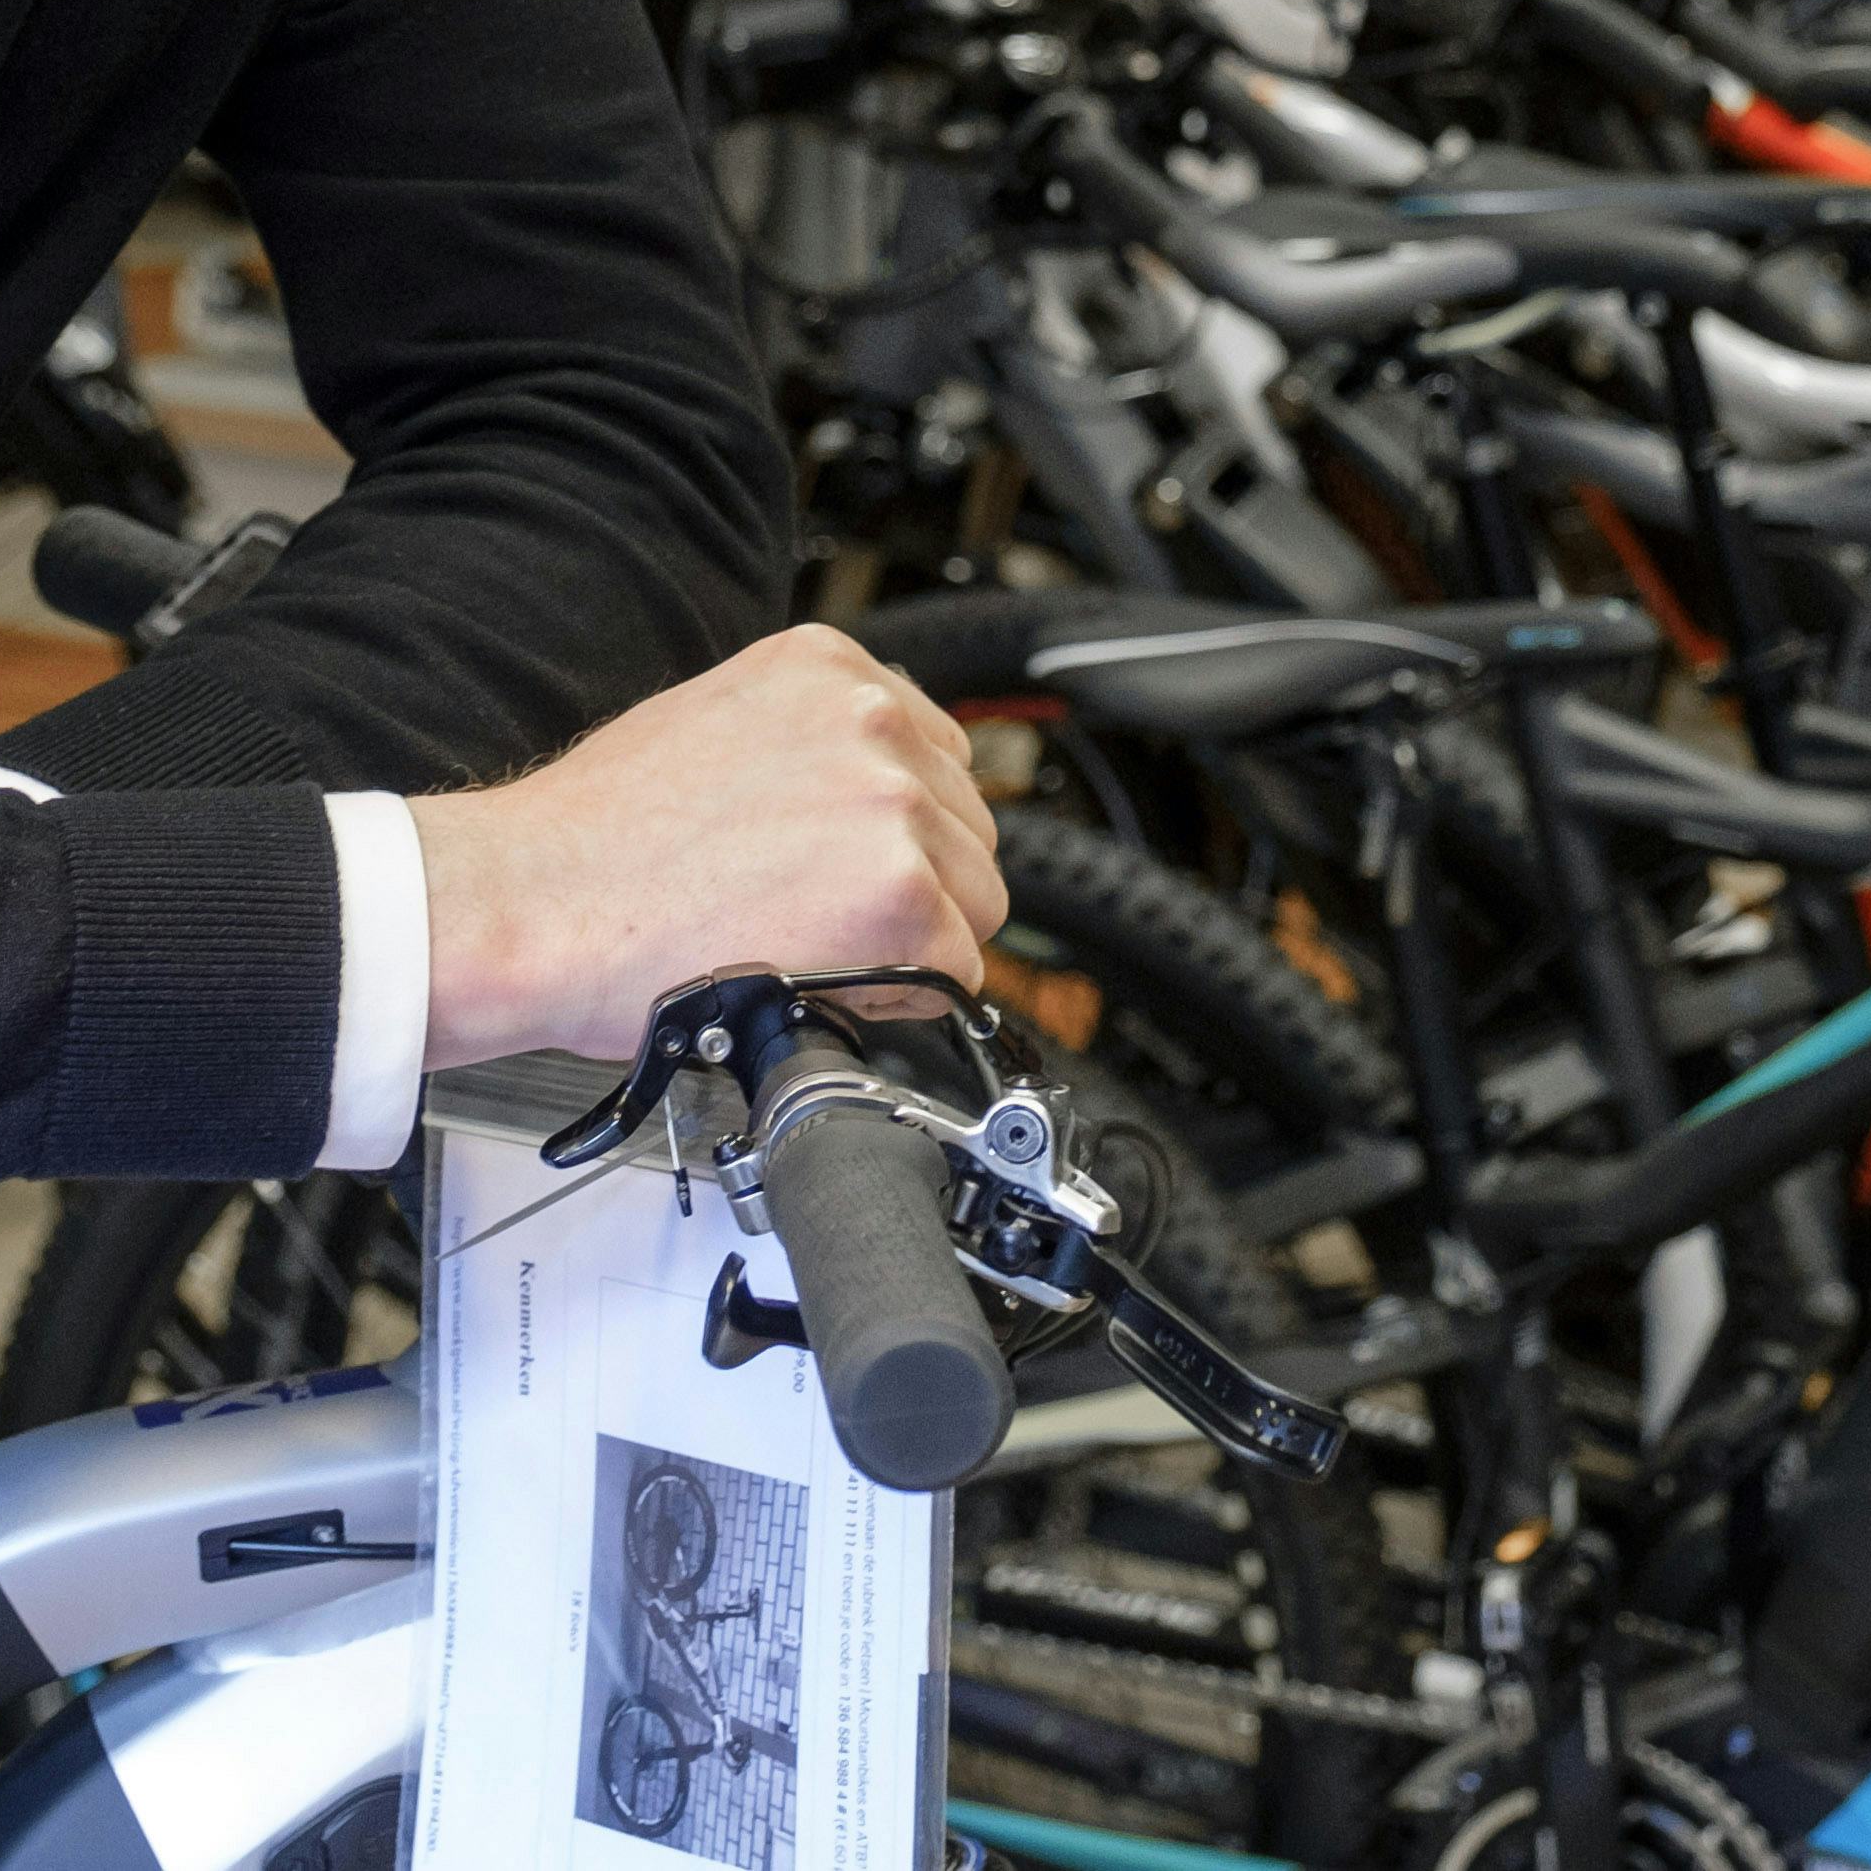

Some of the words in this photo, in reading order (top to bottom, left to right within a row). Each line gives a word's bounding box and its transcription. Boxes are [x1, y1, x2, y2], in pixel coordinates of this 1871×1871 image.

[517, 1259, 536, 1397] Kenmerken
[846, 1499, 858, 1514] 11
[864, 1483, 878, 1551] ovenaan
[845, 1522, 857, 1547] 111
[843, 1553, 854, 1570] en
[863, 1554, 876, 1574] de
[841, 1575, 855, 1612] toets
[862, 1576, 876, 1627] rubriek
[839, 1614, 852, 1630] je
[840, 1632, 853, 1669] code
[860, 1631, 875, 1686] Fietsen
[857, 1697, 873, 1805] Mountainbikes
[856, 1809, 867, 1826] en
